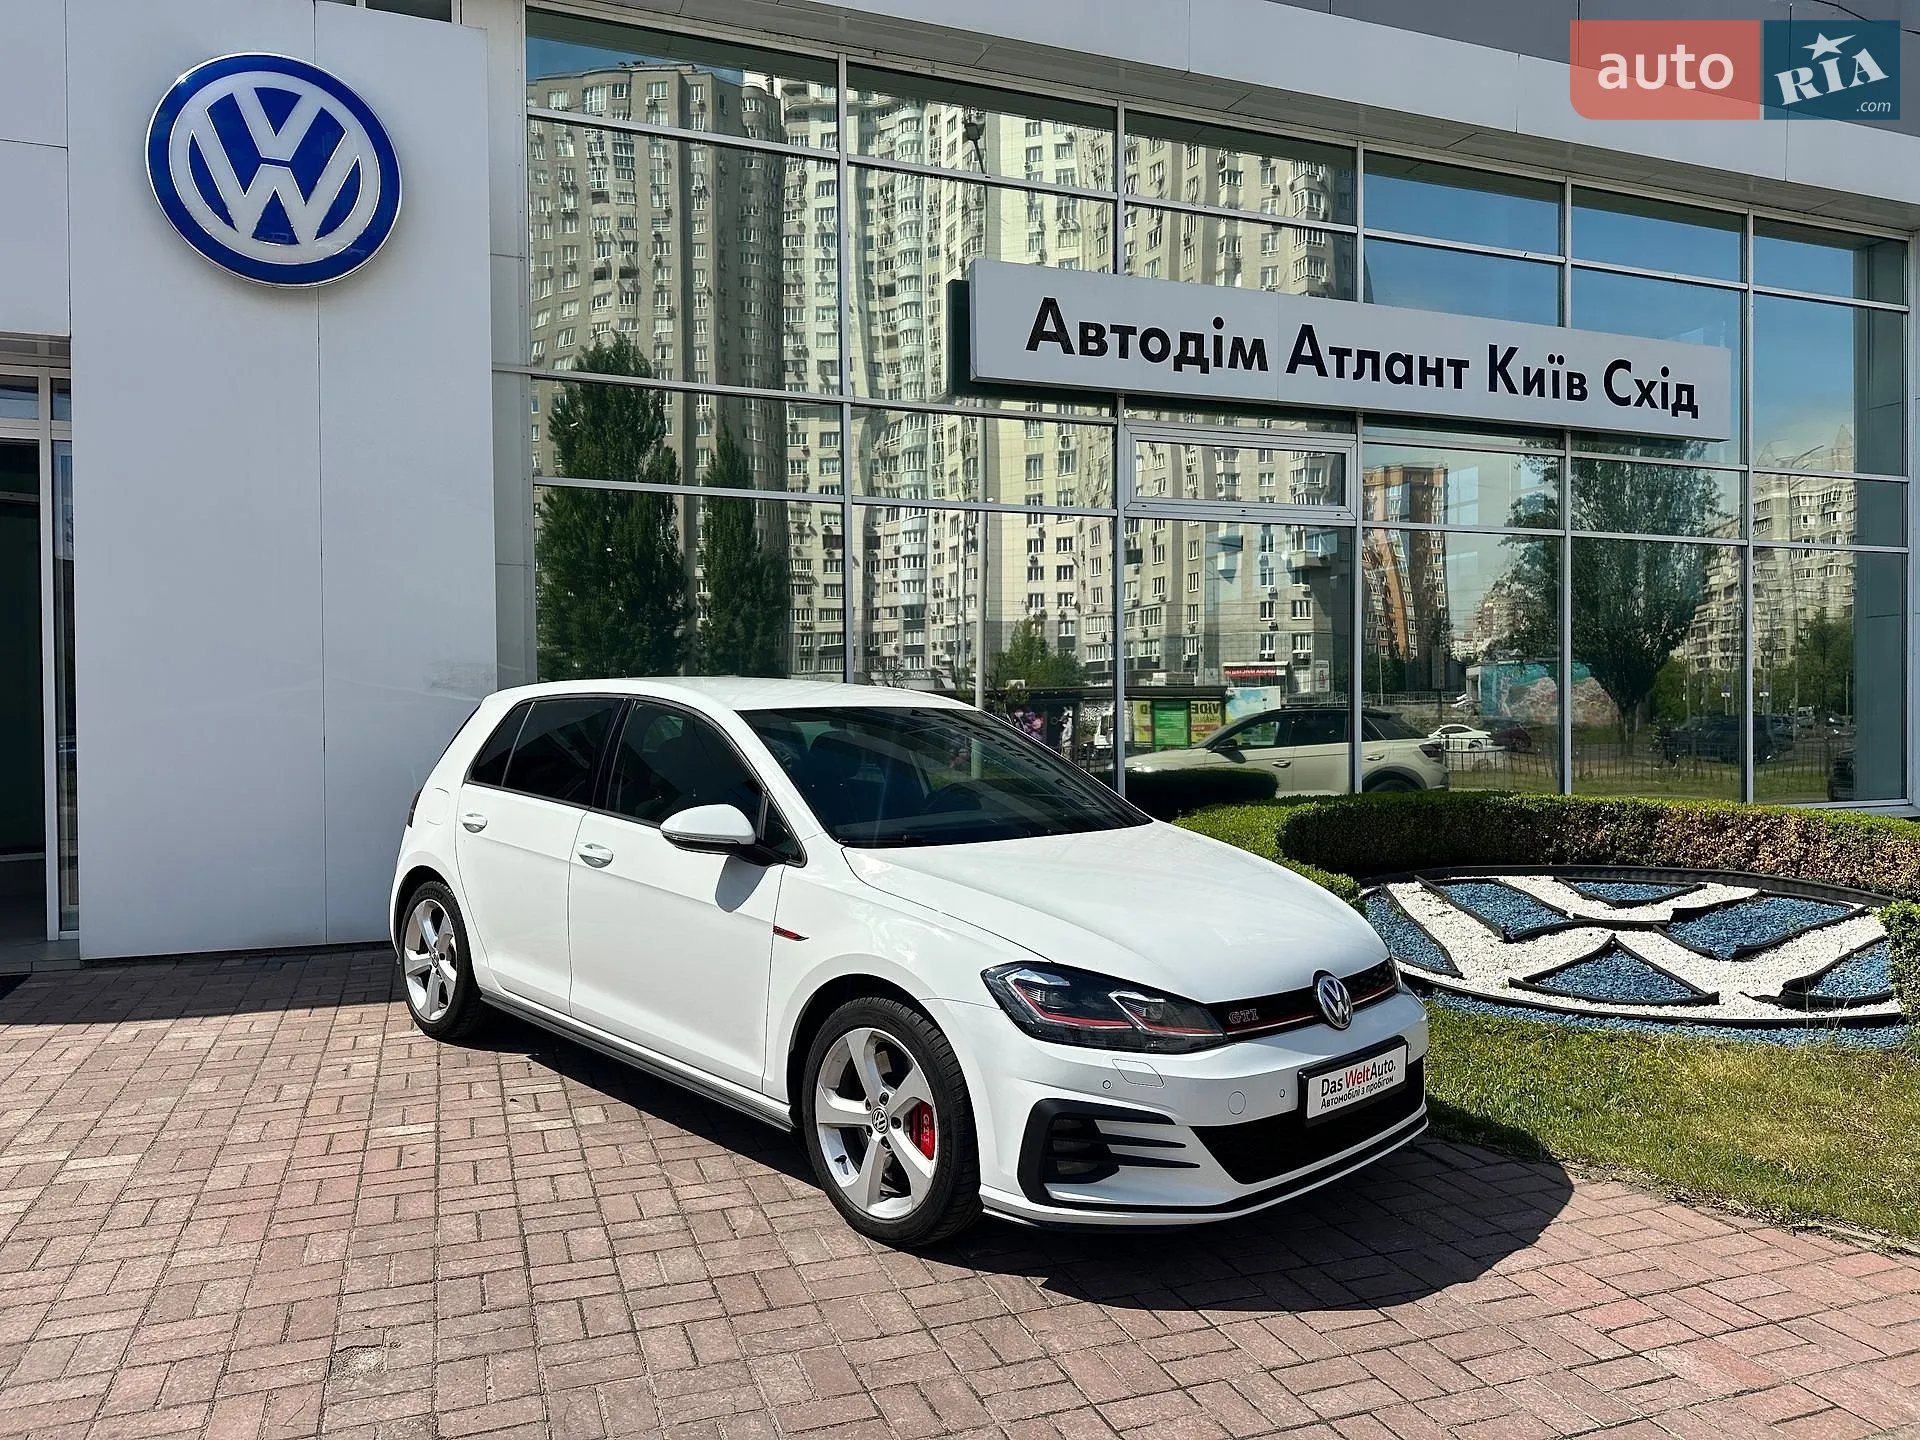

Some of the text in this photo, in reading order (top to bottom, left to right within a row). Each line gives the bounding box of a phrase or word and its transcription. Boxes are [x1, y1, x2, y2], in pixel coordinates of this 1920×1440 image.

[1025, 296, 1699, 420] Автодім Атлант Київ Схід
[1228, 1008, 1259, 1025] GTI
[1321, 1078, 1343, 1097] Das
[1321, 1086, 1360, 1109] Автомобілі
[1366, 1075, 1393, 1094] пробігом
[922, 1113, 930, 1144] GTI
